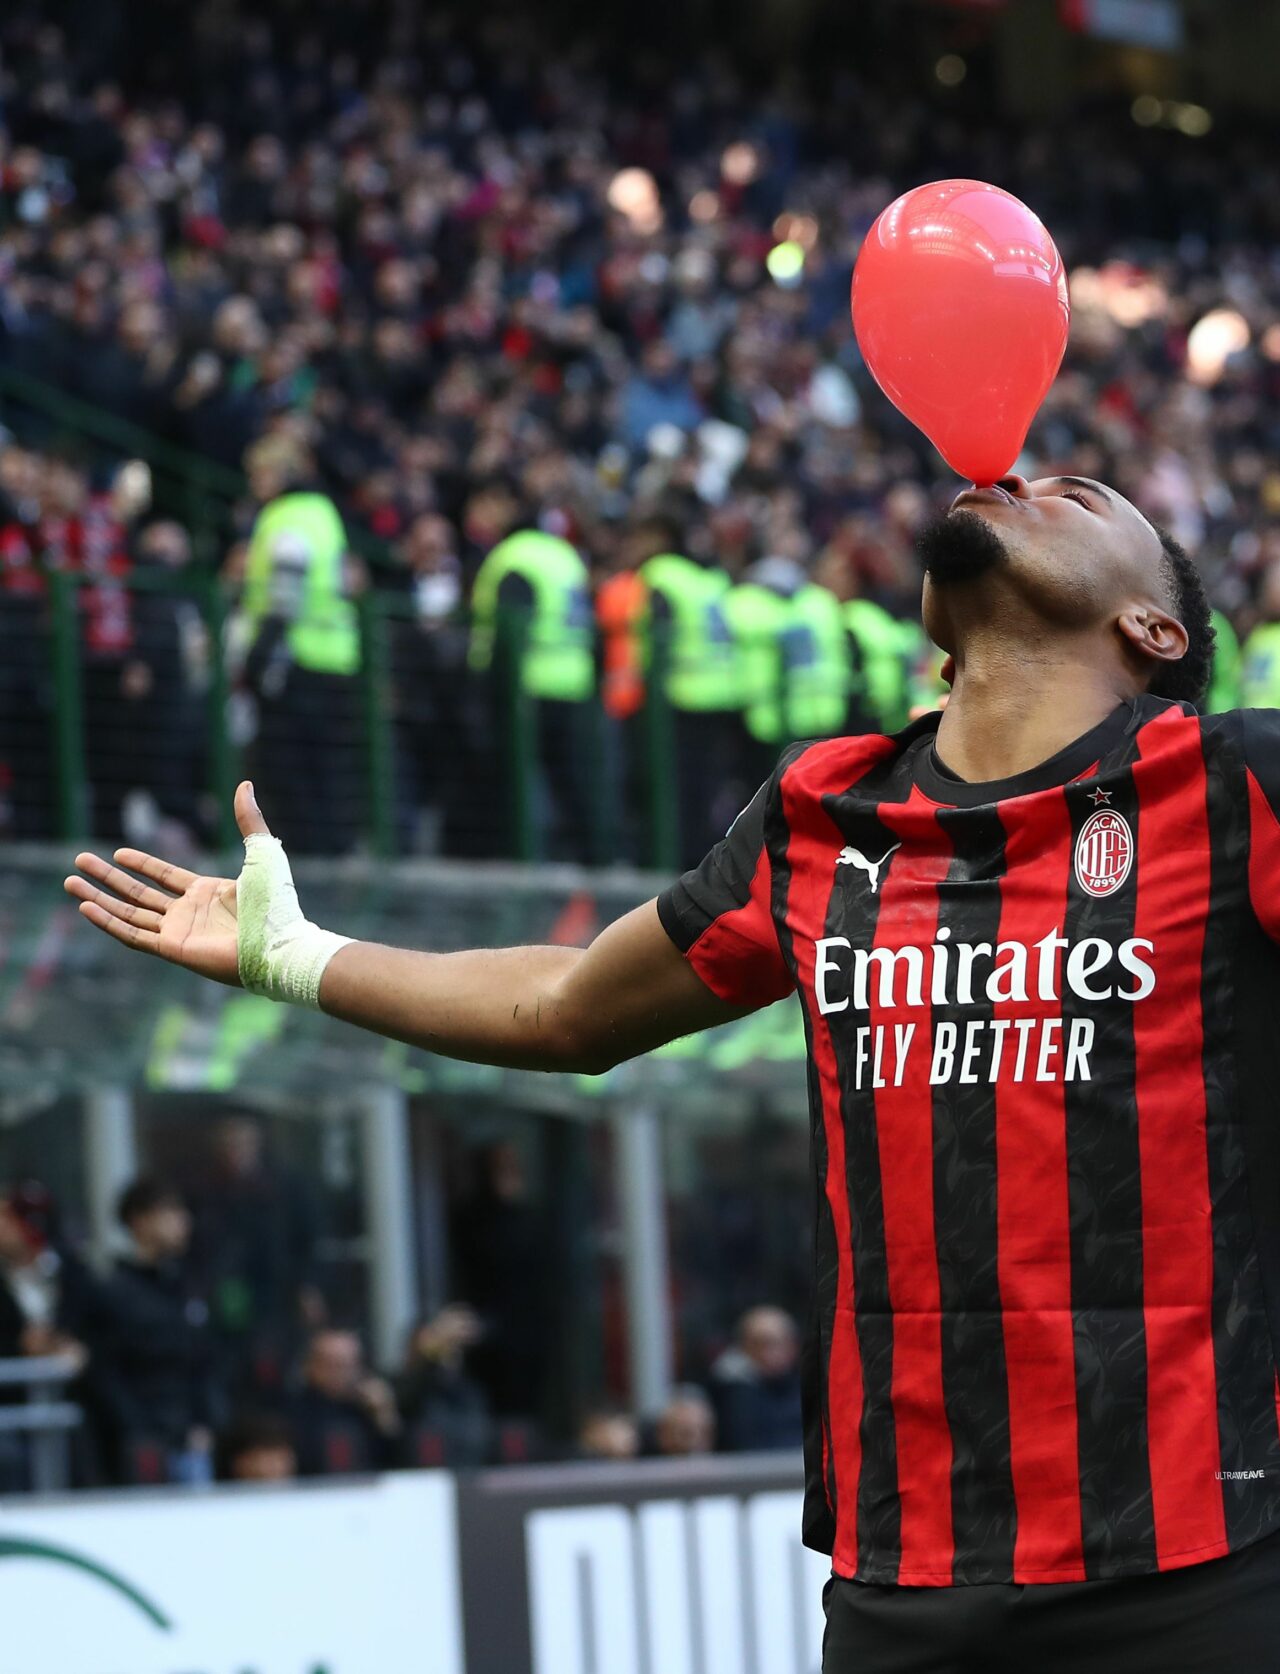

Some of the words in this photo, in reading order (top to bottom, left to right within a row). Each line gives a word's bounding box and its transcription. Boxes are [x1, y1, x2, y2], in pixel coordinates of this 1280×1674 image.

[1088, 816, 1121, 836] ACM
[1088, 876, 1117, 888] 1899
[814, 926, 1157, 1015] Emirates
[855, 1022, 916, 1090] FLY
[928, 1017, 1096, 1085] BETTER
[1214, 1469, 1265, 1480] ULTRAWEAVE
